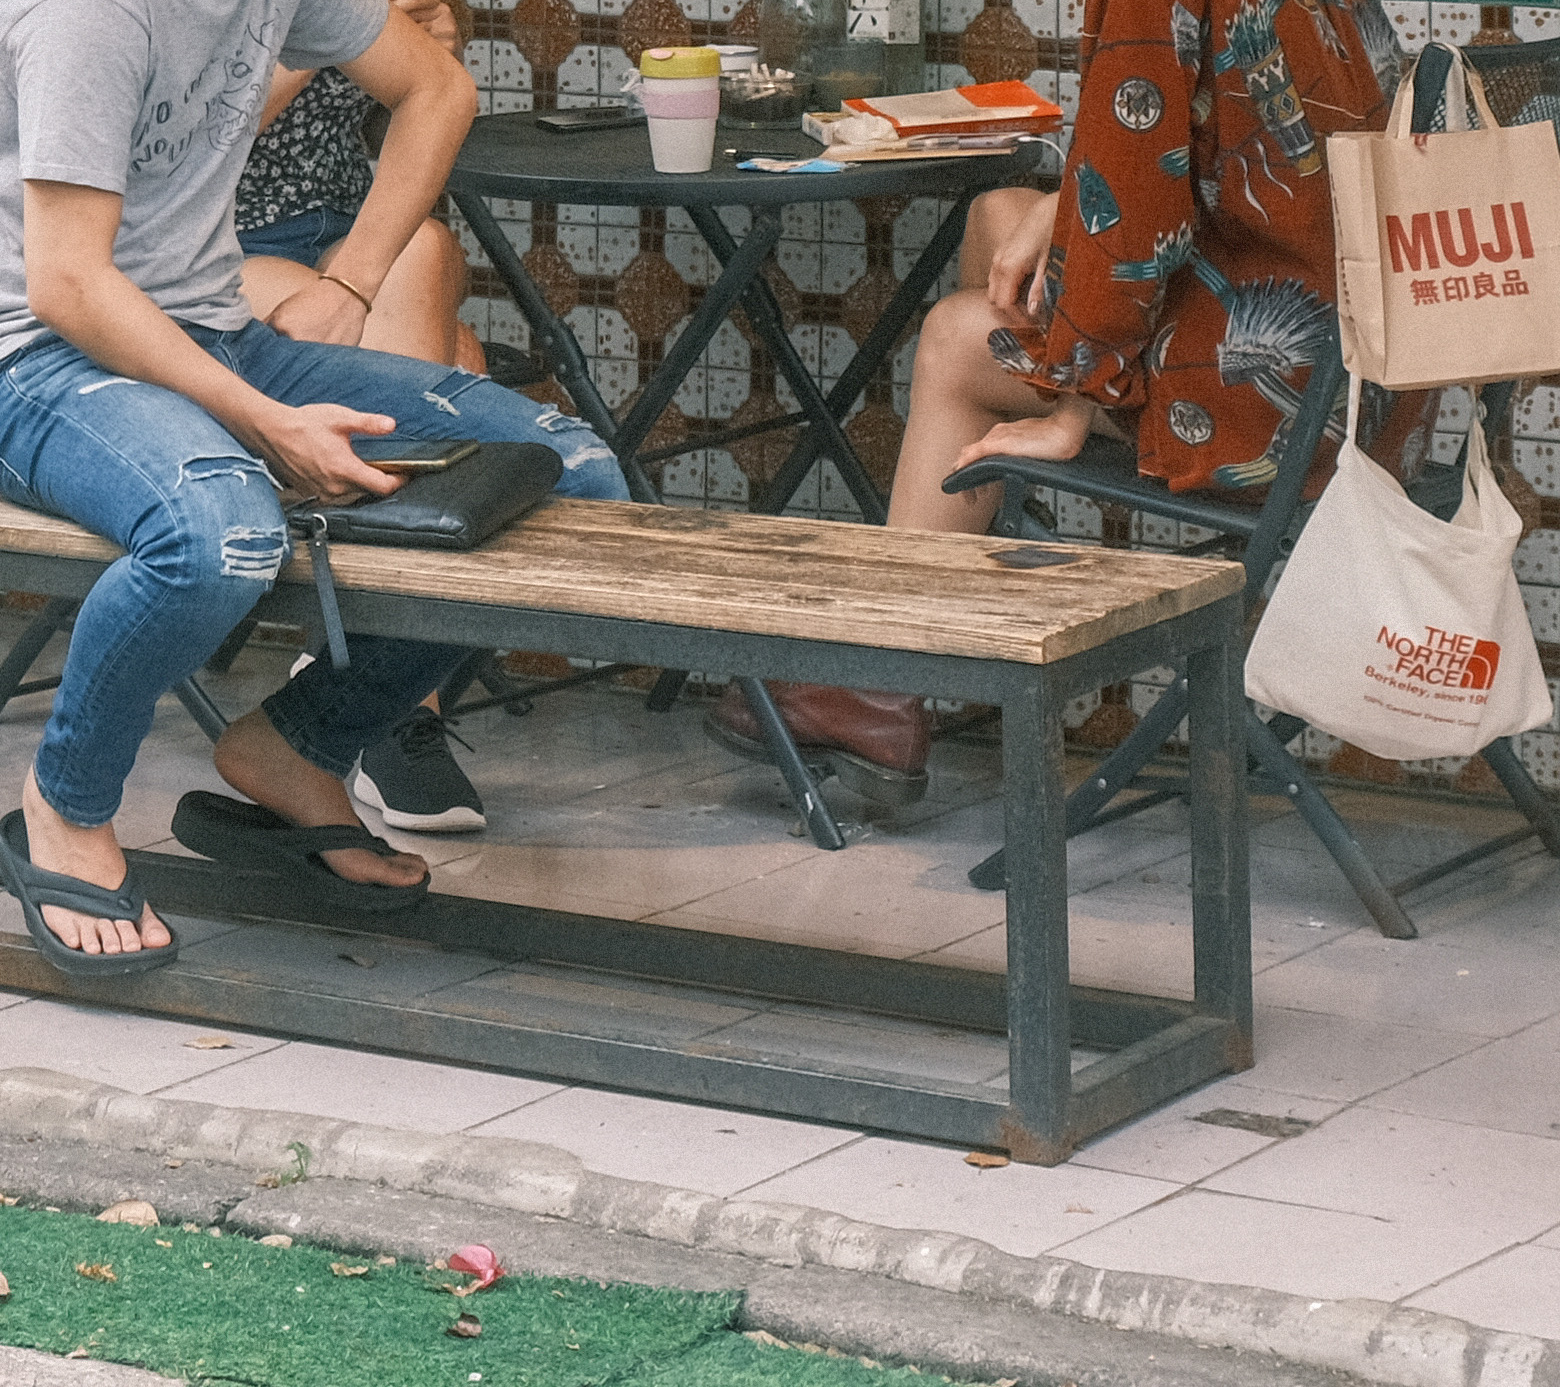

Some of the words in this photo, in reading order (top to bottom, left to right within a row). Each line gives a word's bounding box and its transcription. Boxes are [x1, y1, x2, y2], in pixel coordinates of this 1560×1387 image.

[1385, 201, 1535, 273] MUJI
[1409, 269, 1530, 306] 無印良品
[1376, 626, 1467, 670] NORTH
[1425, 626, 1473, 655] THE
[1364, 665, 1430, 698] Berkeley,
[1434, 692, 1466, 703] since
[1395, 657, 1462, 688] FACE
